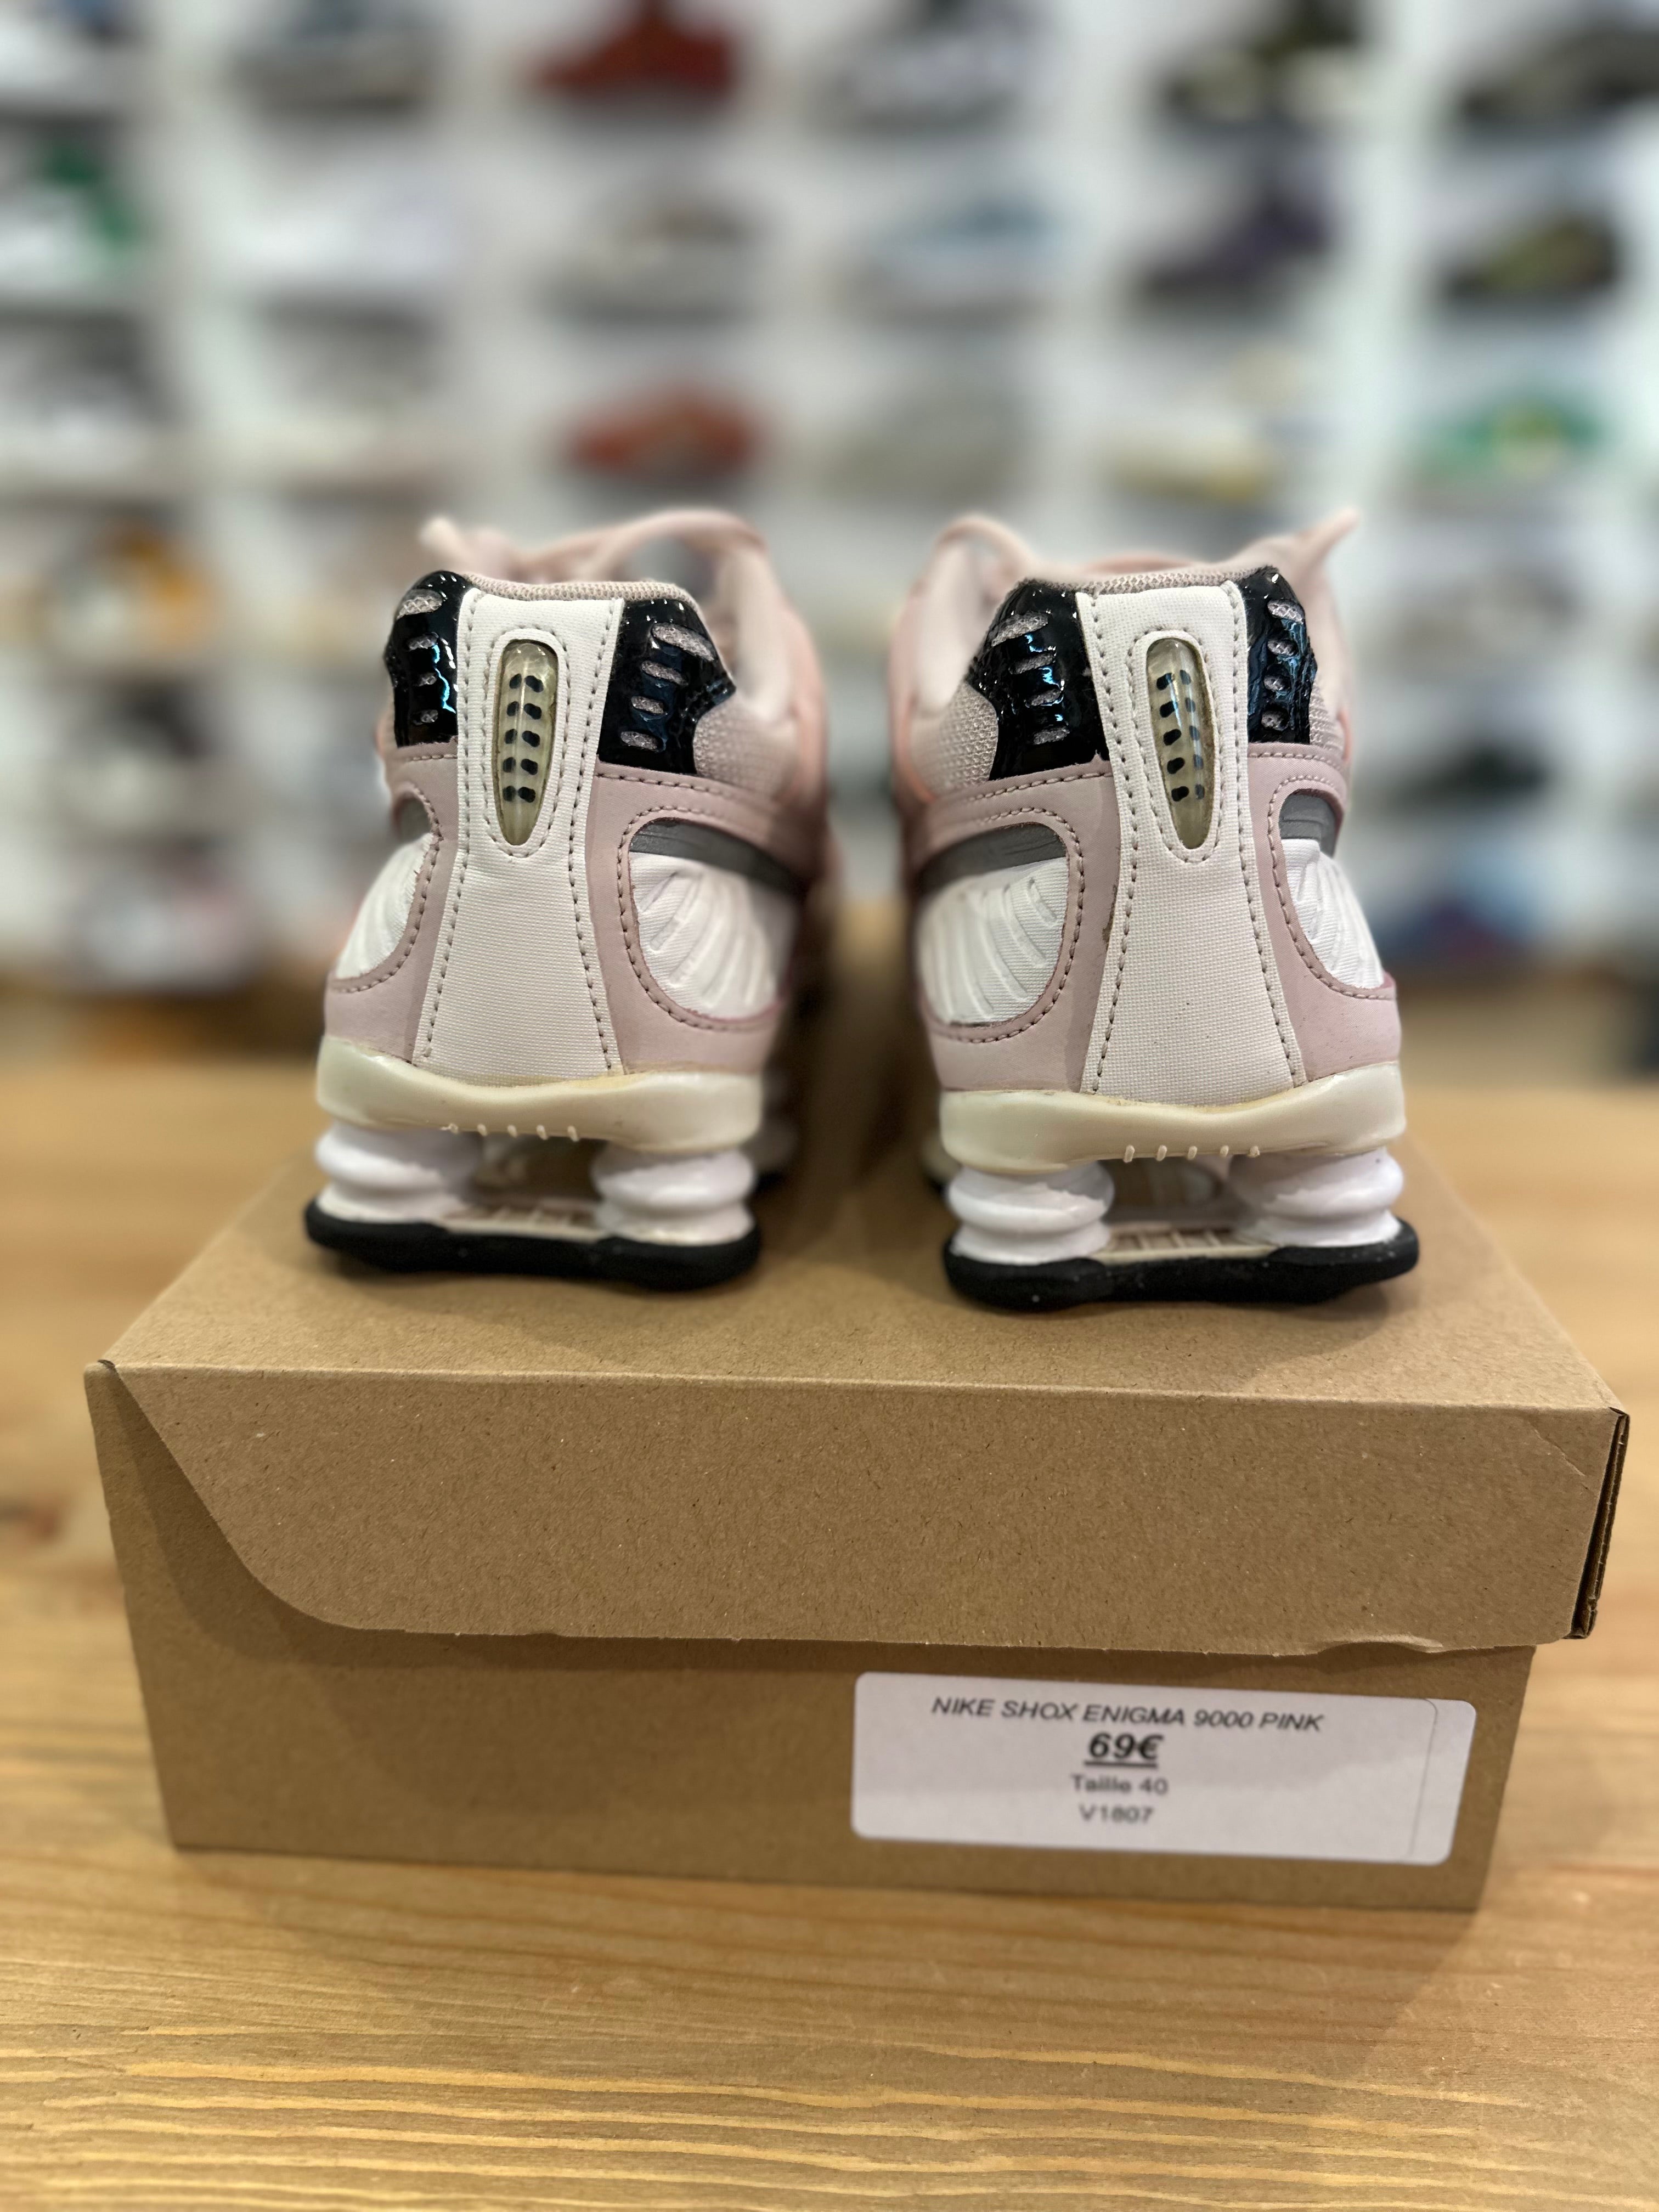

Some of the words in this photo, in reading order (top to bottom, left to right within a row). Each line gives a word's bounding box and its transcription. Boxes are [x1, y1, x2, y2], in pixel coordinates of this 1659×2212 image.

[931, 1696, 996, 1718] NIKE
[1001, 1700, 1079, 1721] SHOX
[1082, 1703, 1186, 1726] ENIGMA
[1193, 1709, 1255, 1730] 9000
[1258, 1712, 1325, 1733] PINK
[1087, 1731, 1165, 1763] 69€
[1070, 1773, 1132, 1793] Taille
[1139, 1776, 1170, 1796] 40
[1078, 1804, 1155, 1824] V1807
